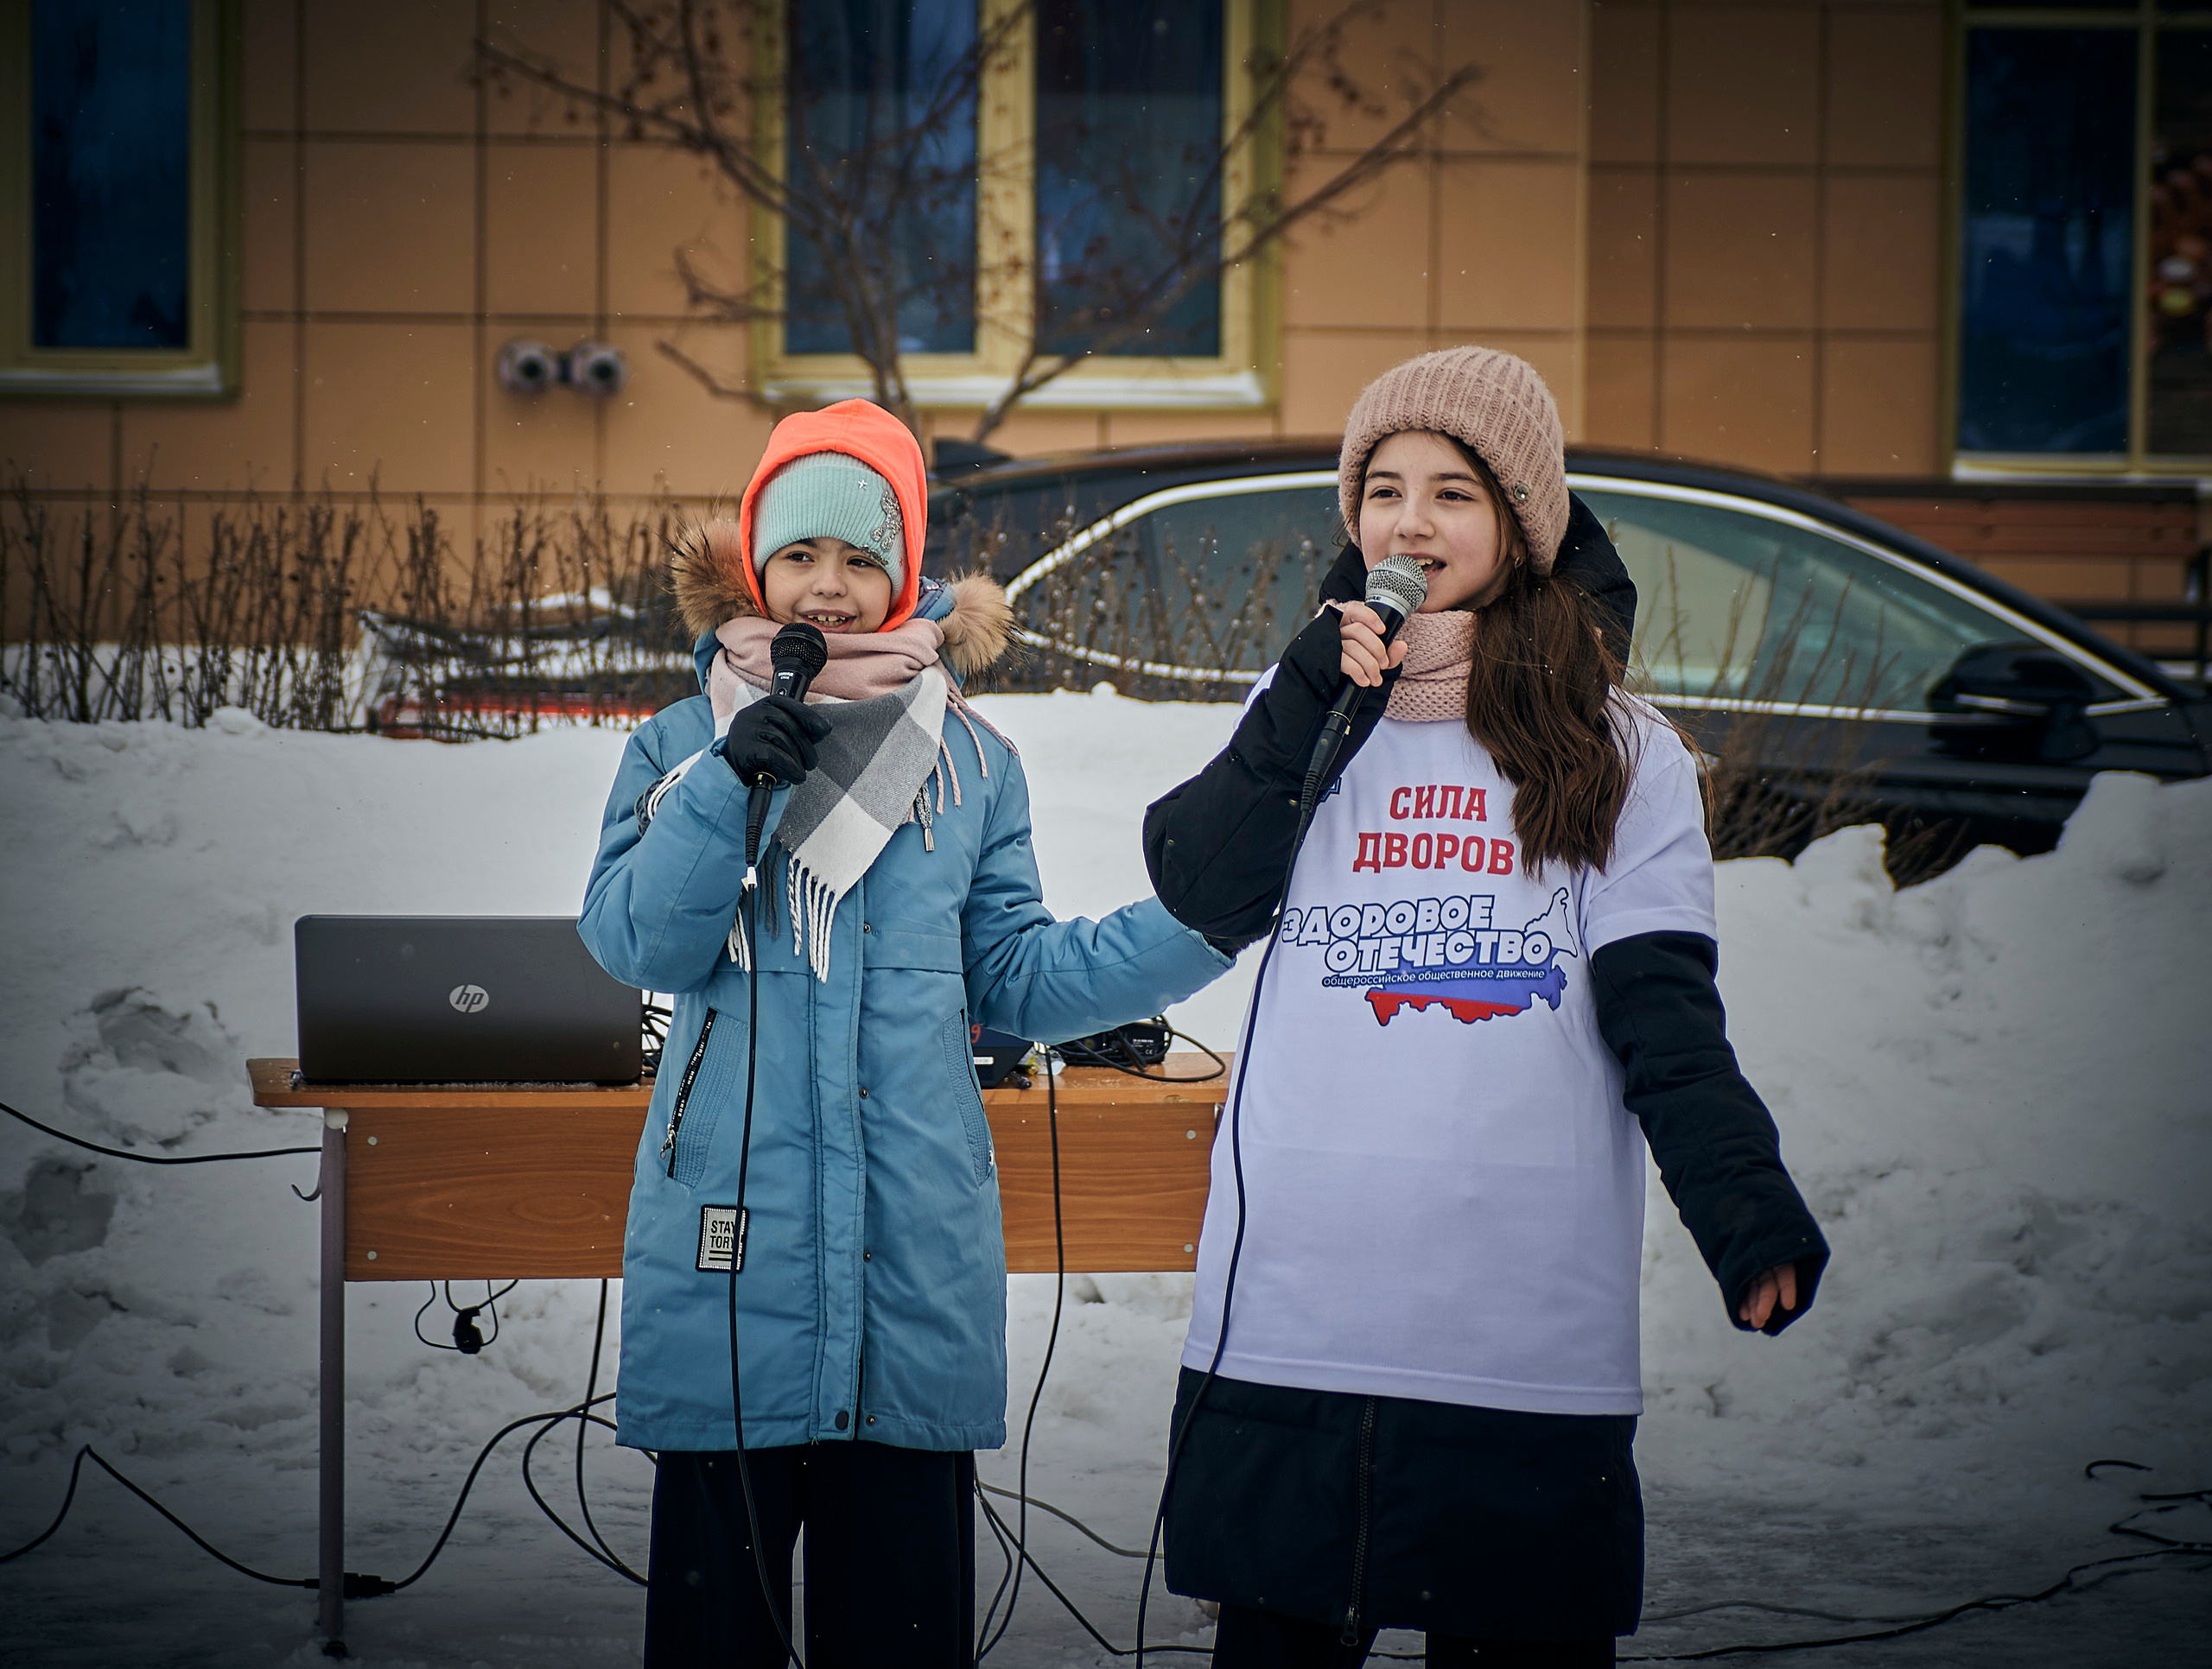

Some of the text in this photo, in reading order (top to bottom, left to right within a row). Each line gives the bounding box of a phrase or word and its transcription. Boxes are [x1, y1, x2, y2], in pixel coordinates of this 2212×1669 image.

[1389, 785, 1487, 822] СИЛА
[1352, 832, 1515, 875] ДВОРОВ
[1281, 894, 1496, 947] ЗДОРОВОЕ
[1324, 930, 1553, 974] ОТЕЧЕСТВО
[1323, 968, 1545, 987] общероссийское общественное движение
[454, 984, 486, 1013] hp
[710, 1220, 735, 1234] STAY
